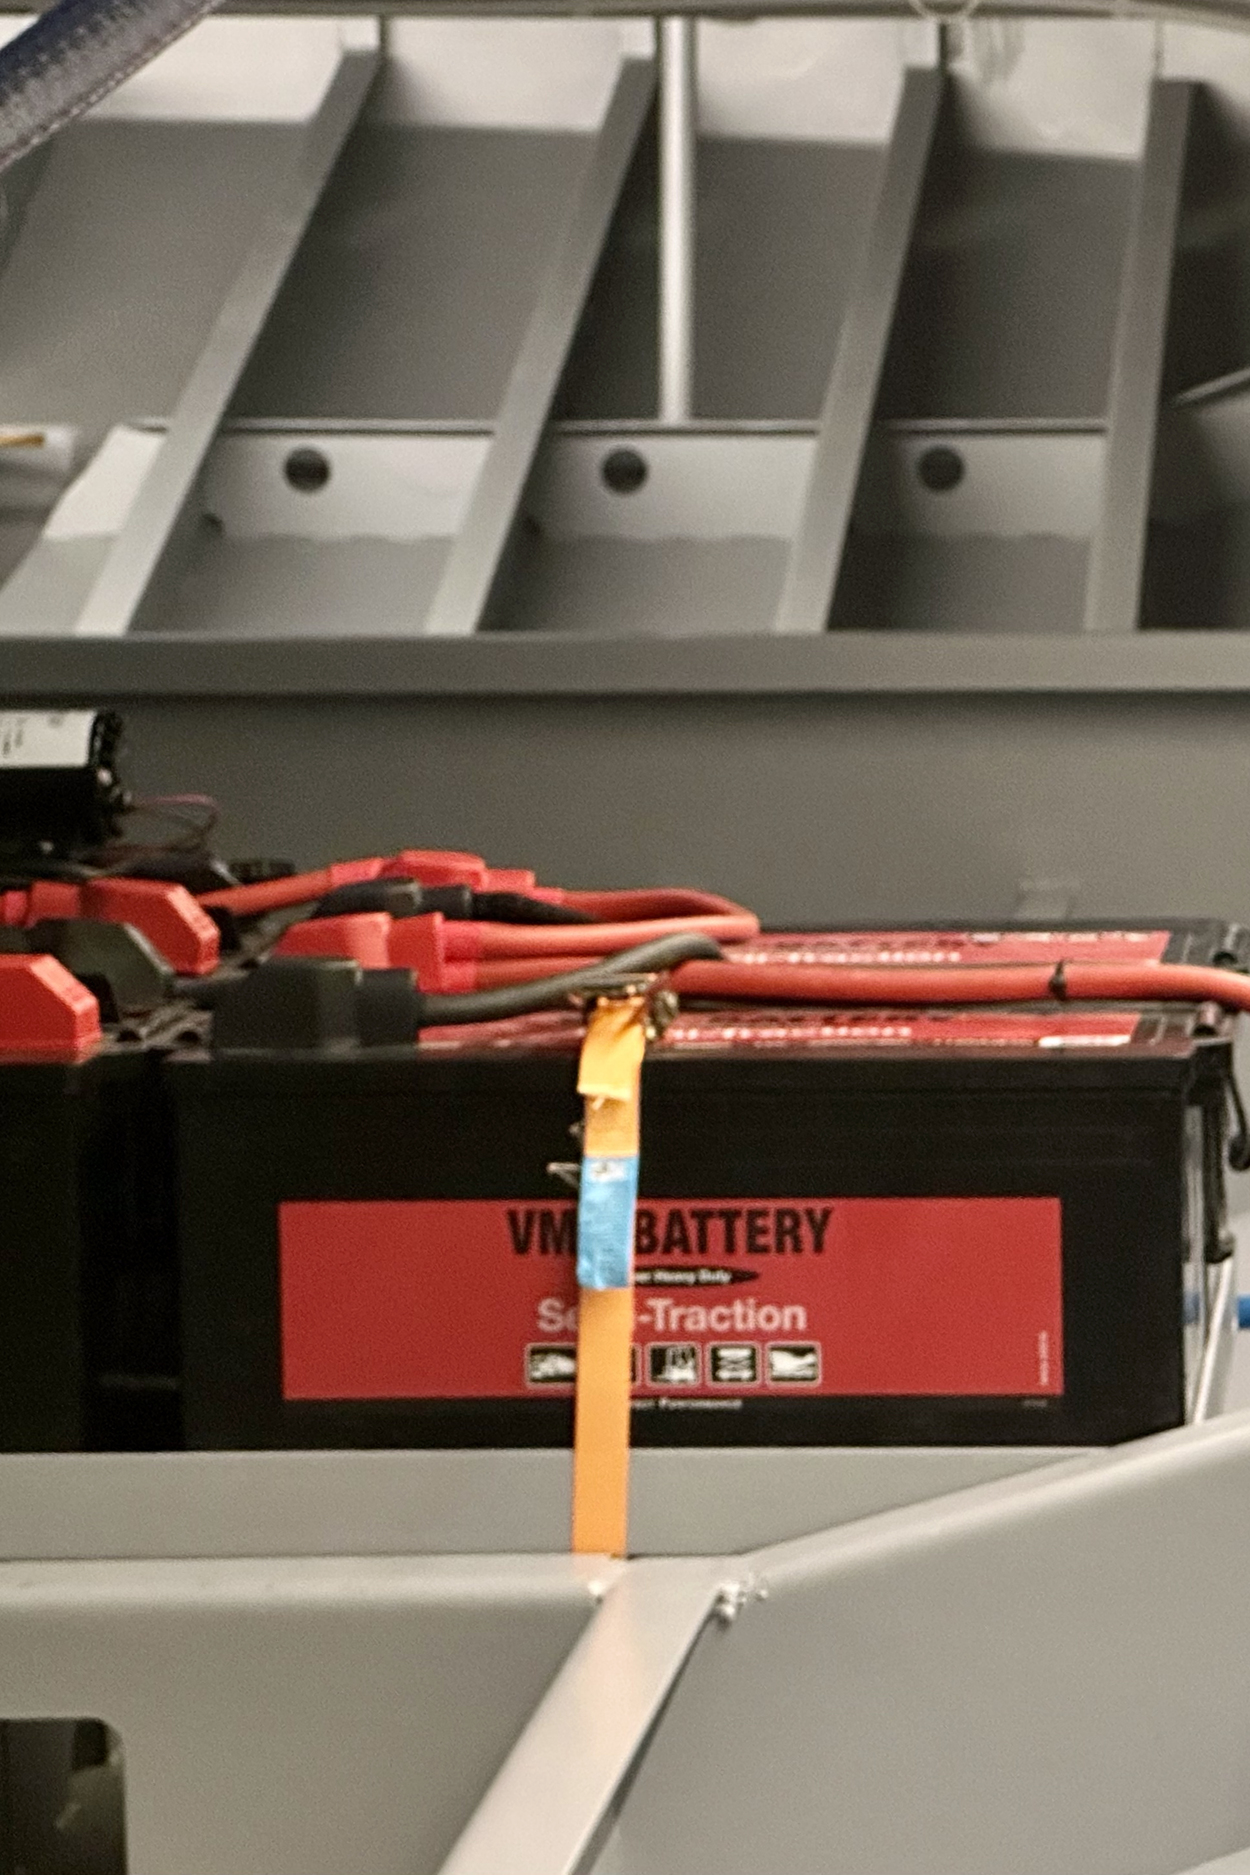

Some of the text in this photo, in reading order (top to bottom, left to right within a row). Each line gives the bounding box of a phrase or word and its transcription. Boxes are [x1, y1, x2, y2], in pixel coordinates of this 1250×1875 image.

[506, 1207, 834, 1256] VM BATTERY
[537, 1297, 808, 1333] Se-Traction
